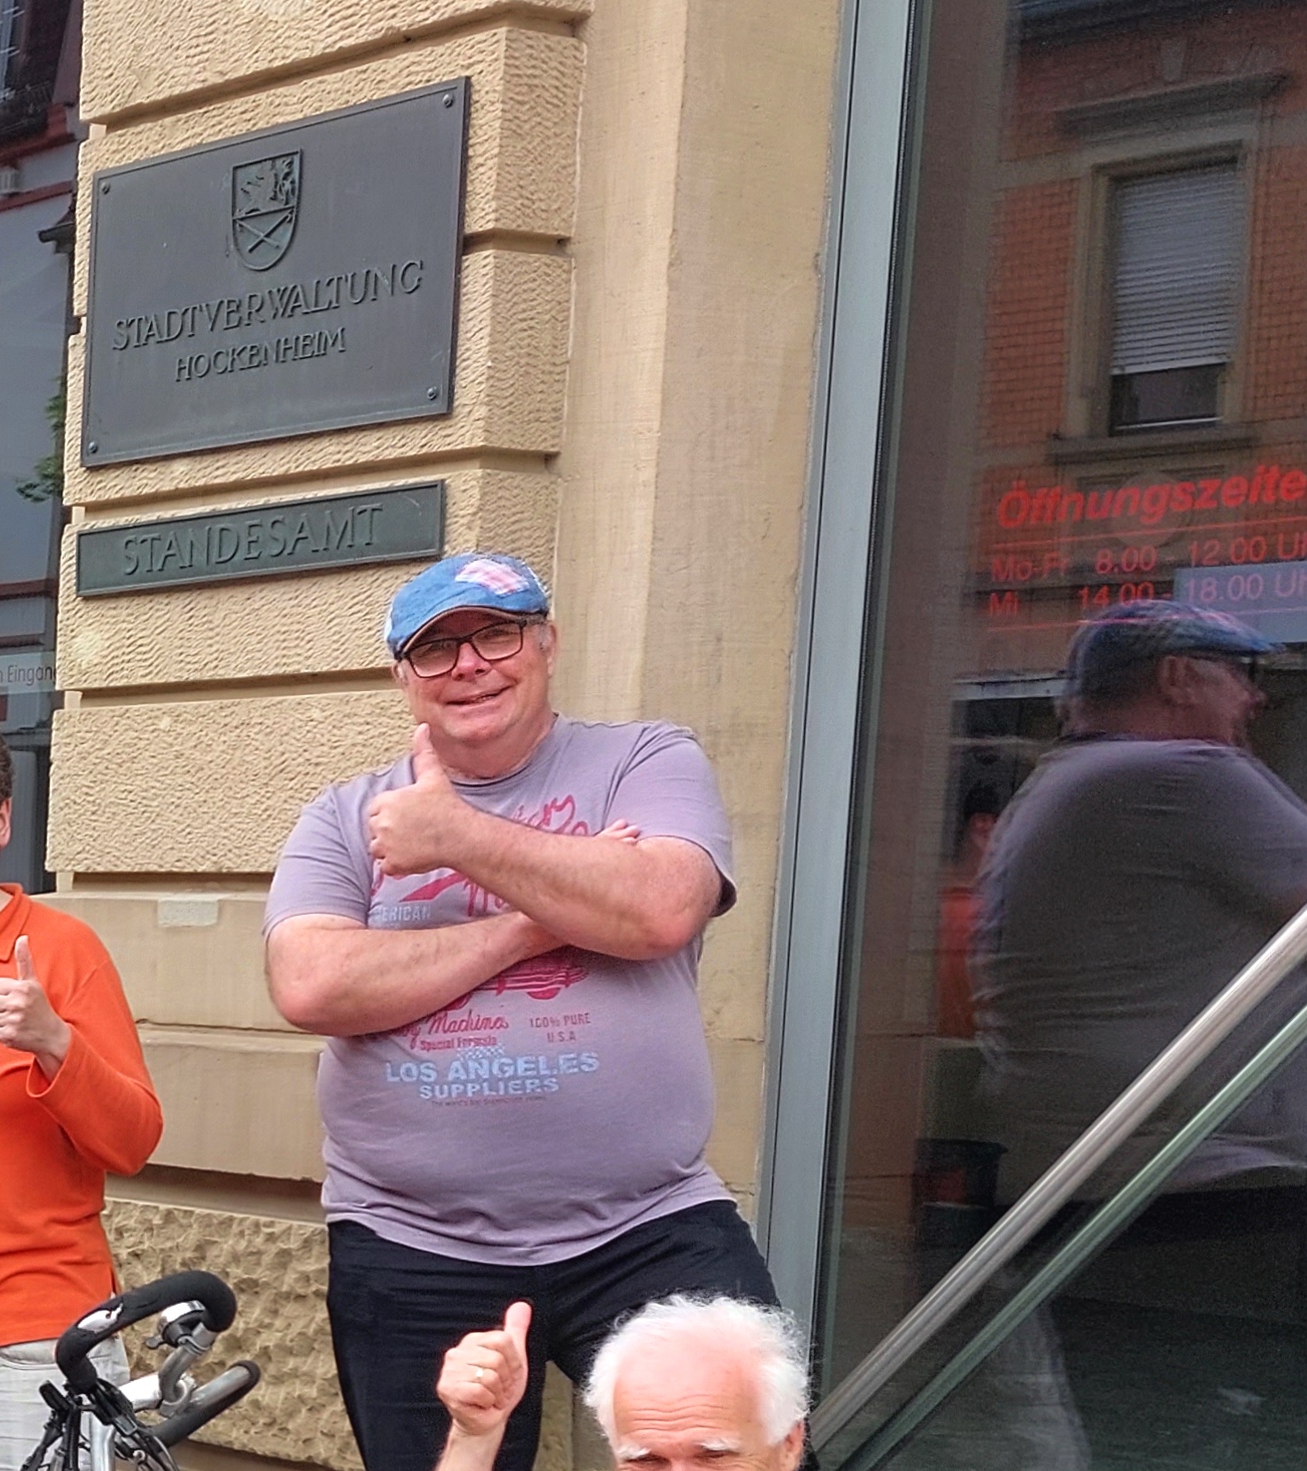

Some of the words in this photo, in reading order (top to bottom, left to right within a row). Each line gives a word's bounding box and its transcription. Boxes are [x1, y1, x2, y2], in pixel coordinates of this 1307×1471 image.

[112, 260, 423, 350] STADTVERWALTUNG
[175, 327, 346, 382] HOCKENHEIM
[997, 463, 1307, 529] Öffnungszeite
[124, 504, 382, 575] STANDESAMT
[1095, 545, 1158, 575] 8.00
[1185, 572, 1264, 603] 18.00
[385, 1060, 438, 1083] LOS
[447, 1052, 600, 1082] ANGELES
[418, 1077, 560, 1100] SUPPLIERS
